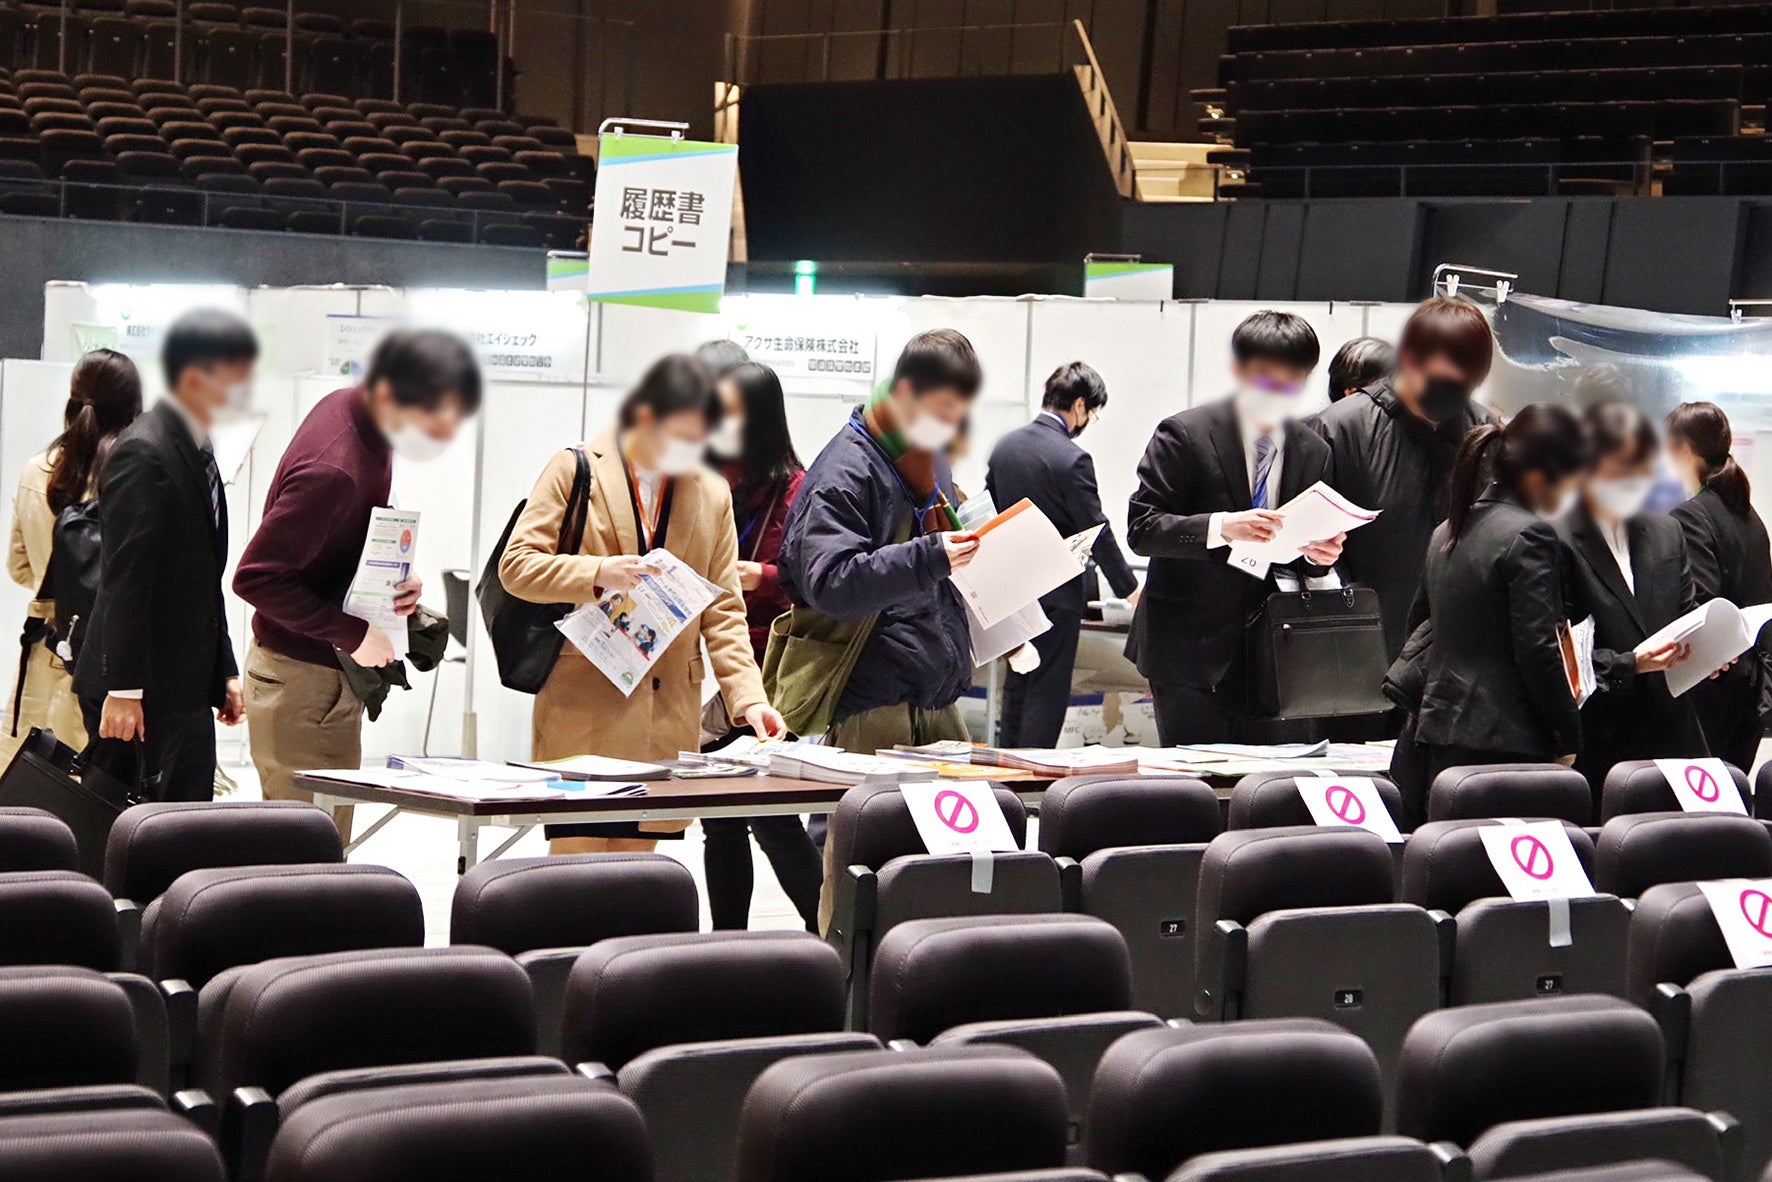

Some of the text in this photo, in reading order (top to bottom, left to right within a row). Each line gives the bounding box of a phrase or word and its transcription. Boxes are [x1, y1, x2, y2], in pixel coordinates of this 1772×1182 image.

[620, 187, 705, 225] 履歴書
[622, 225, 697, 256] コピー
[744, 335, 859, 354] アクサ生命保険株式会社
[1169, 923, 1178, 933] 27
